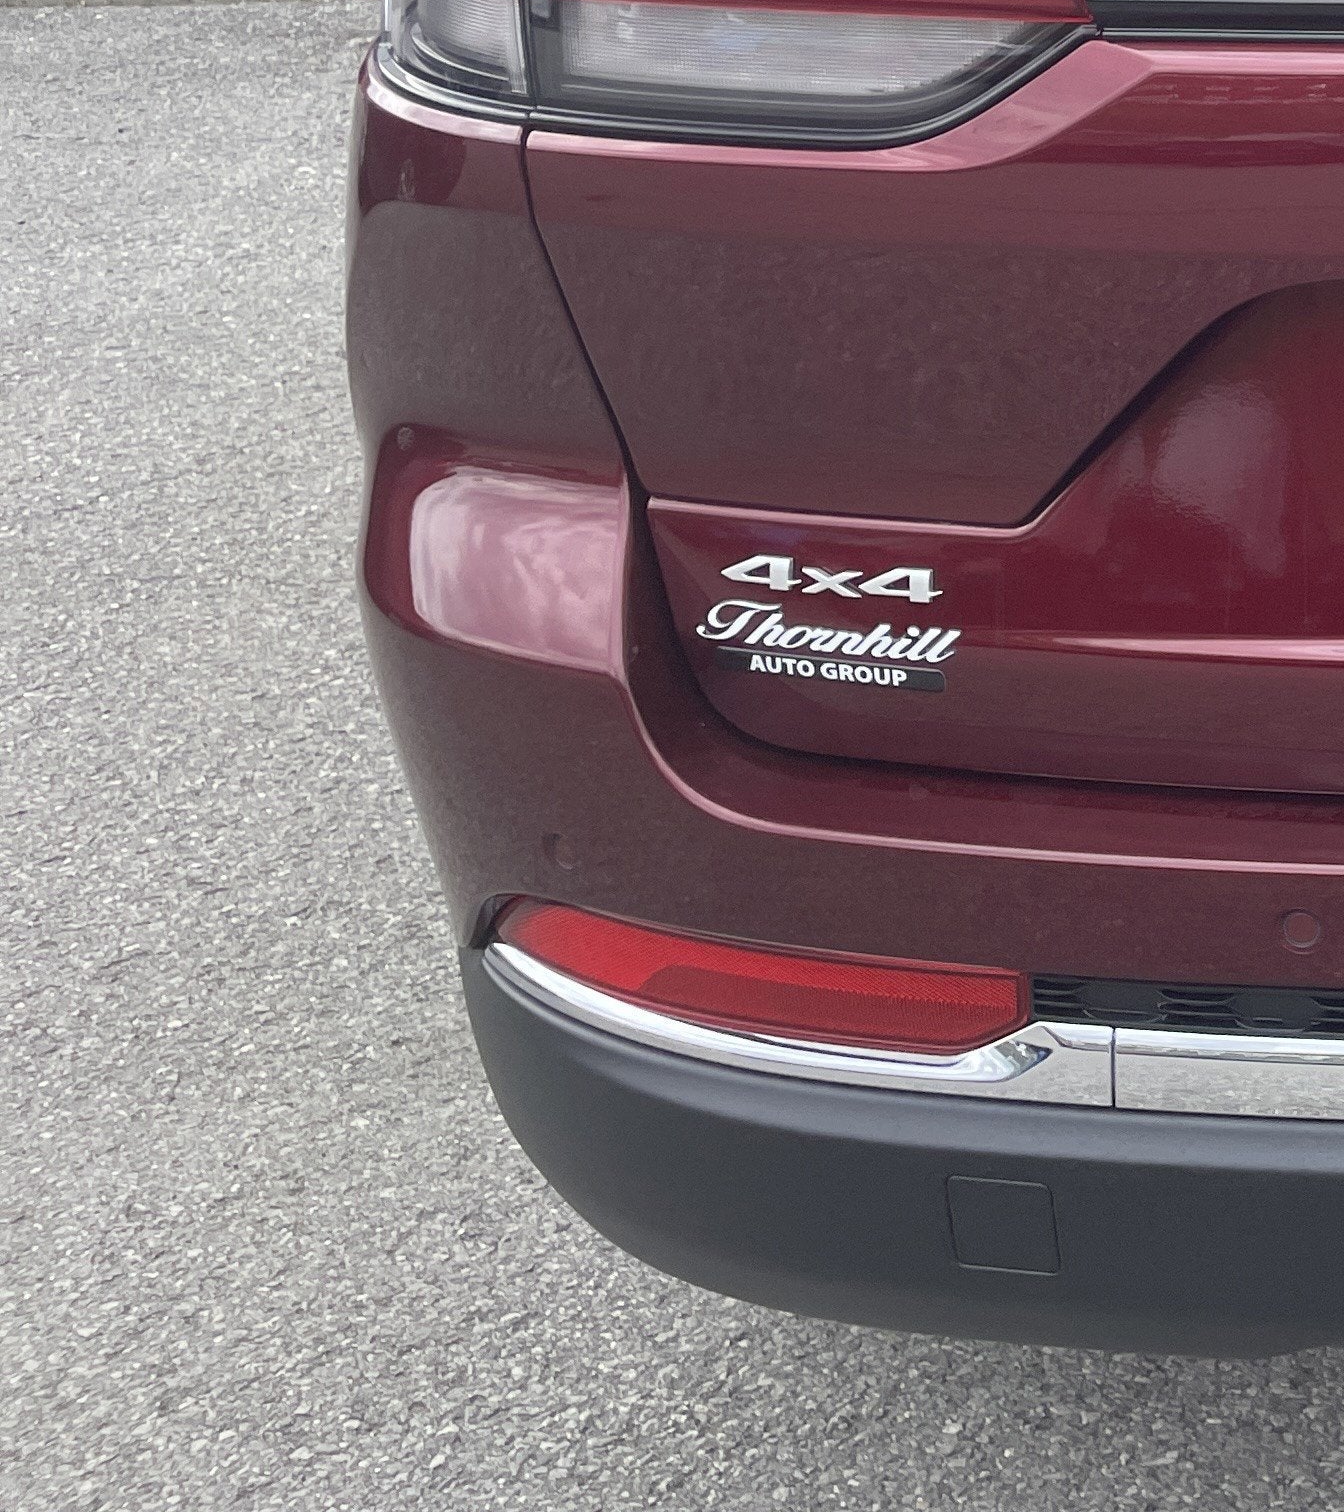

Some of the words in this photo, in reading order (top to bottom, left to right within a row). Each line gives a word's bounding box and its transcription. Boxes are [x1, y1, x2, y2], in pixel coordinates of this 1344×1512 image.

[720, 554, 944, 604] 4x4
[696, 599, 962, 664] Thornhill
[749, 654, 816, 678] AUTO
[819, 662, 908, 688] GROUP
